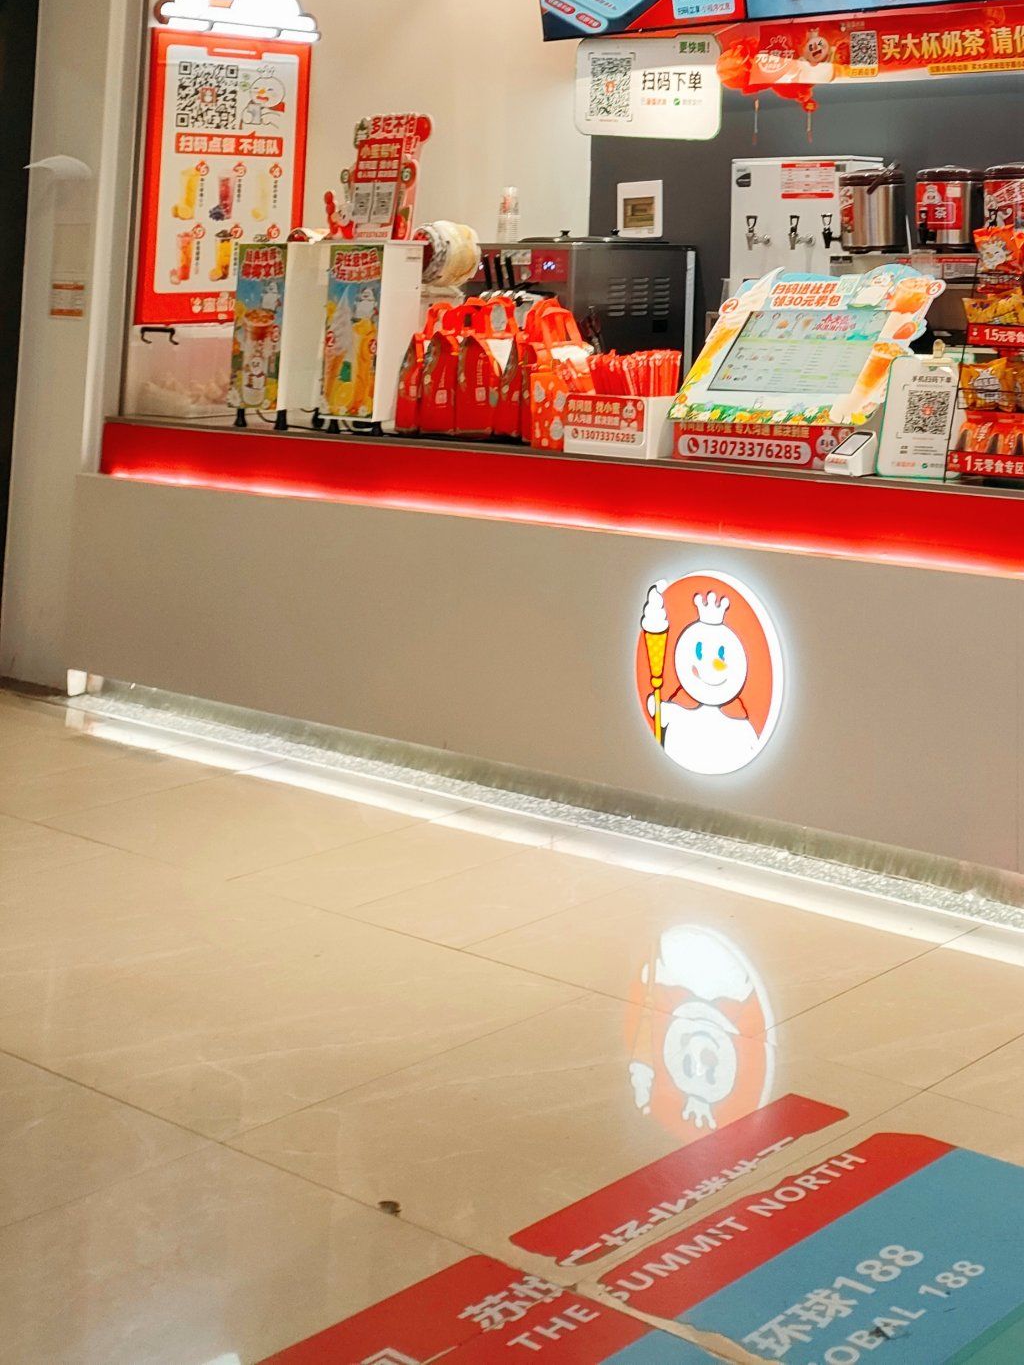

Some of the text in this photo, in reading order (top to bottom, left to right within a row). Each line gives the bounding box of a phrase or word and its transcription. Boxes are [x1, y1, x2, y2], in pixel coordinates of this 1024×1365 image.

[881, 28, 986, 61] 买大杯奶茶
[642, 71, 702, 91] 扫码下单
[179, 135, 280, 155] 扫码点餐 不排队
[772, 282, 838, 295] 扫码进社群
[773, 295, 842, 308] 领30元券包
[581, 429, 636, 443] 13073376285
[702, 439, 802, 461] 13073376285
[964, 455, 1024, 475] 1元零食专区
[506, 1152, 867, 1351] THE SUMMIT NORTH
[743, 1244, 925, 1357] 环球188
[806, 1260, 986, 1365] OBAL 188
